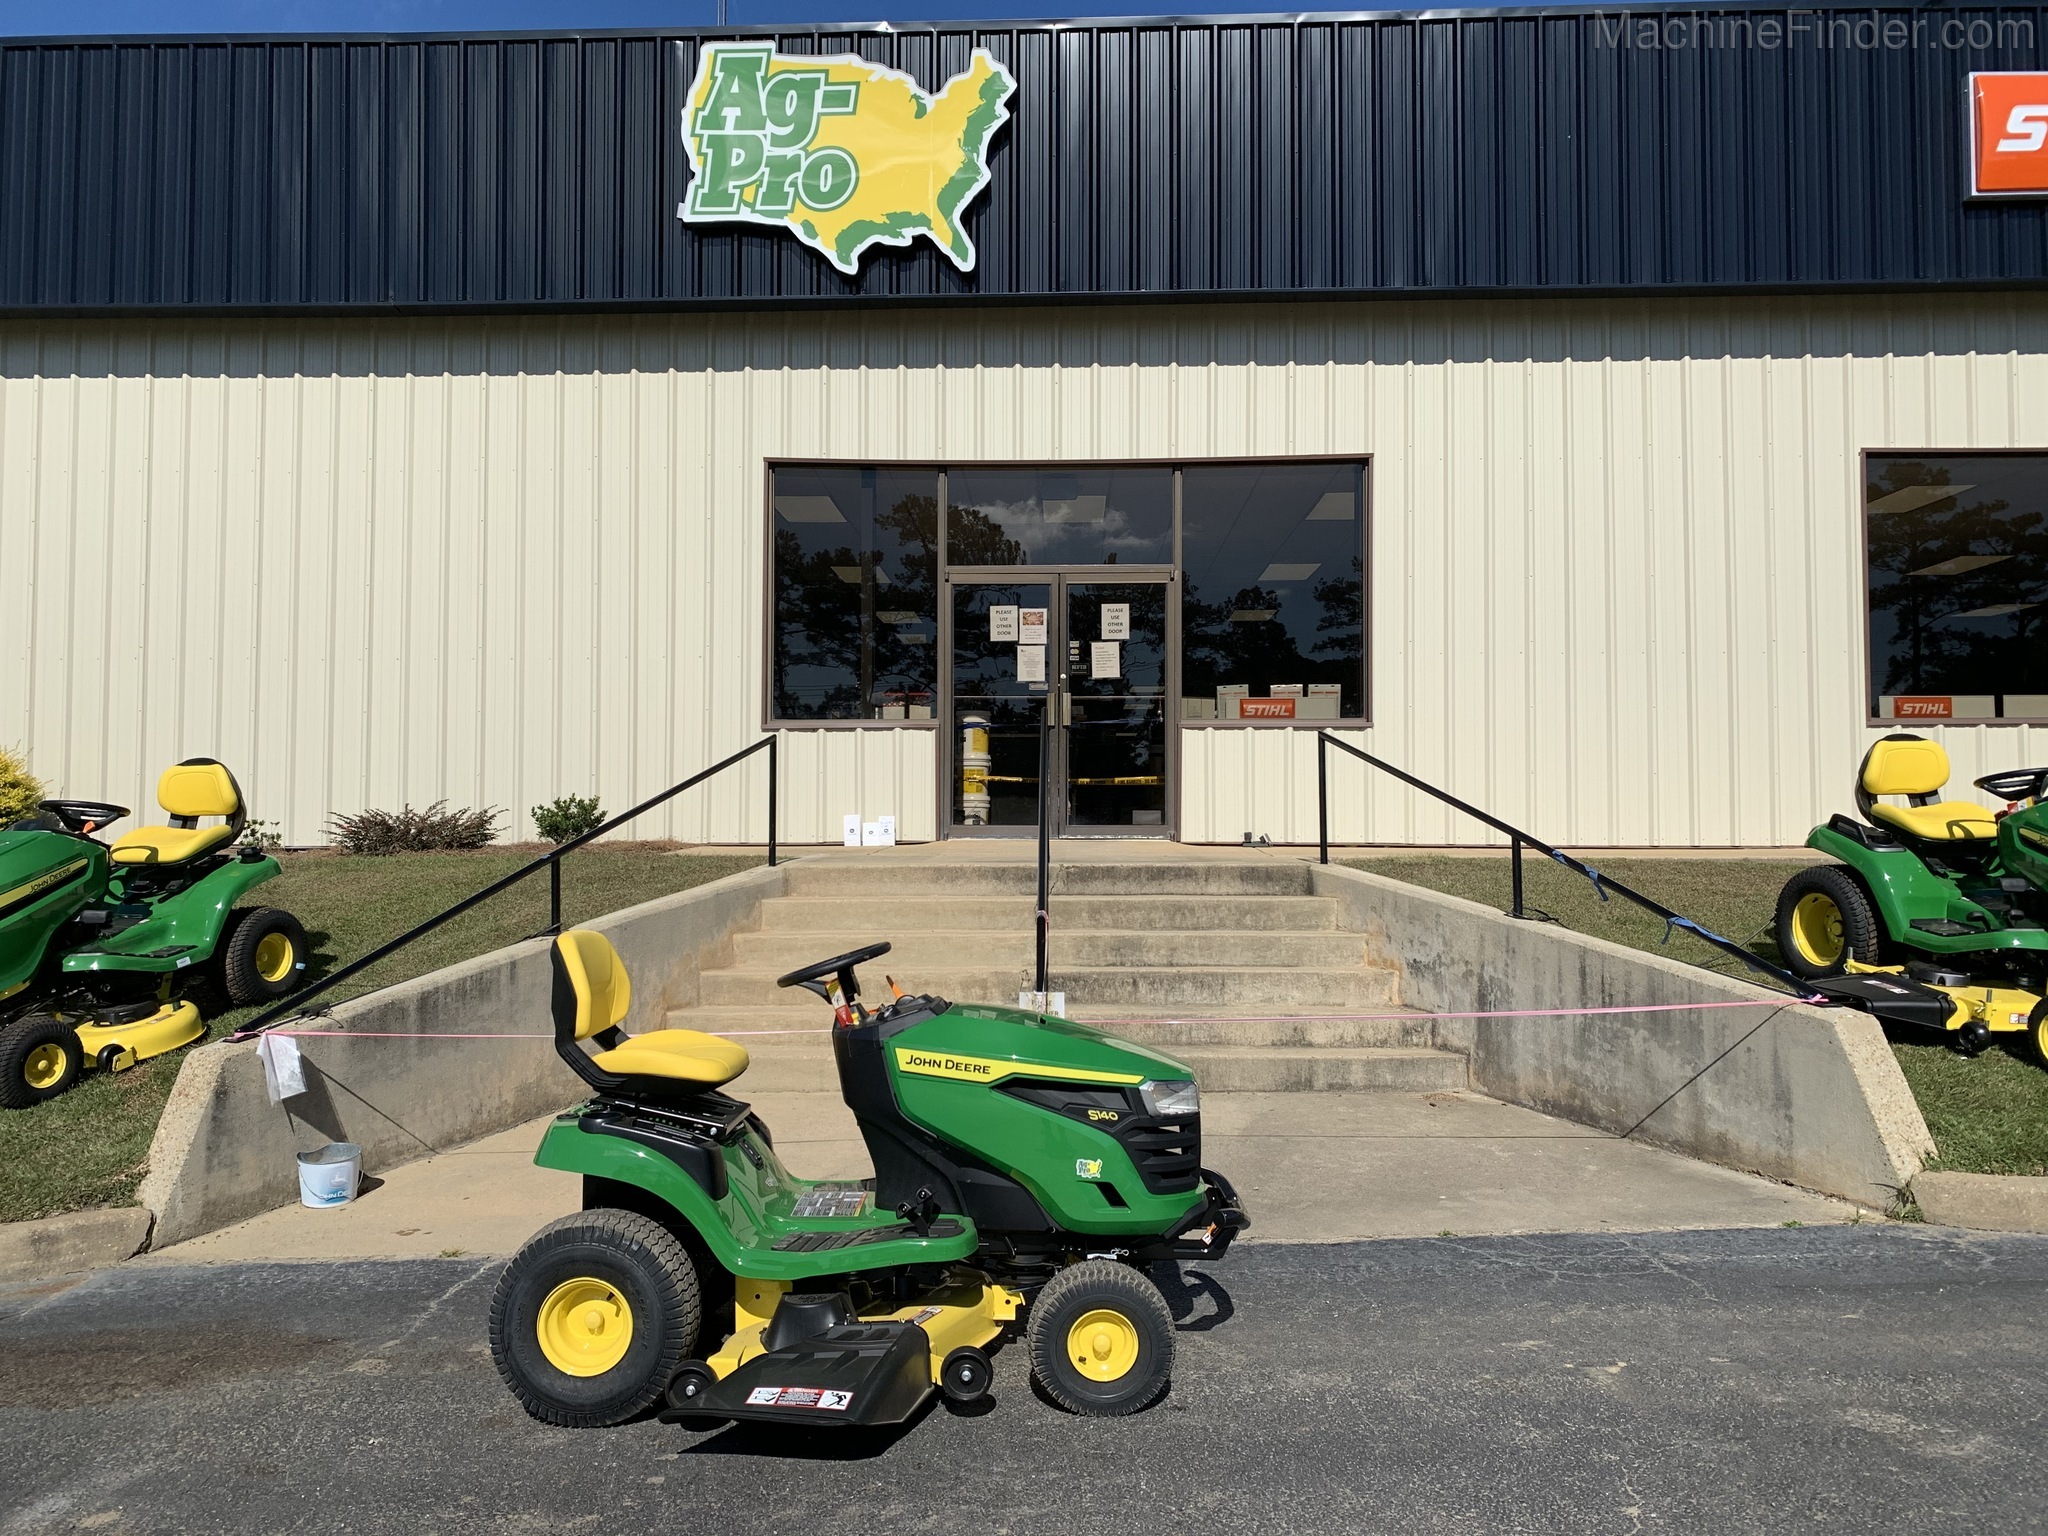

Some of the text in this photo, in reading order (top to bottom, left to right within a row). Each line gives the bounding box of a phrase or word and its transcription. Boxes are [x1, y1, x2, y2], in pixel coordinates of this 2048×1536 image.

[694, 50, 858, 149] Ag-
[692, 135, 857, 212] Pro
[1244, 704, 1290, 716] STIHL
[1901, 703, 1948, 714] STIHL
[29, 867, 72, 894] JOHN DEERE
[905, 1054, 991, 1075] JOHN DEERE
[1087, 1109, 1119, 1121] S140
